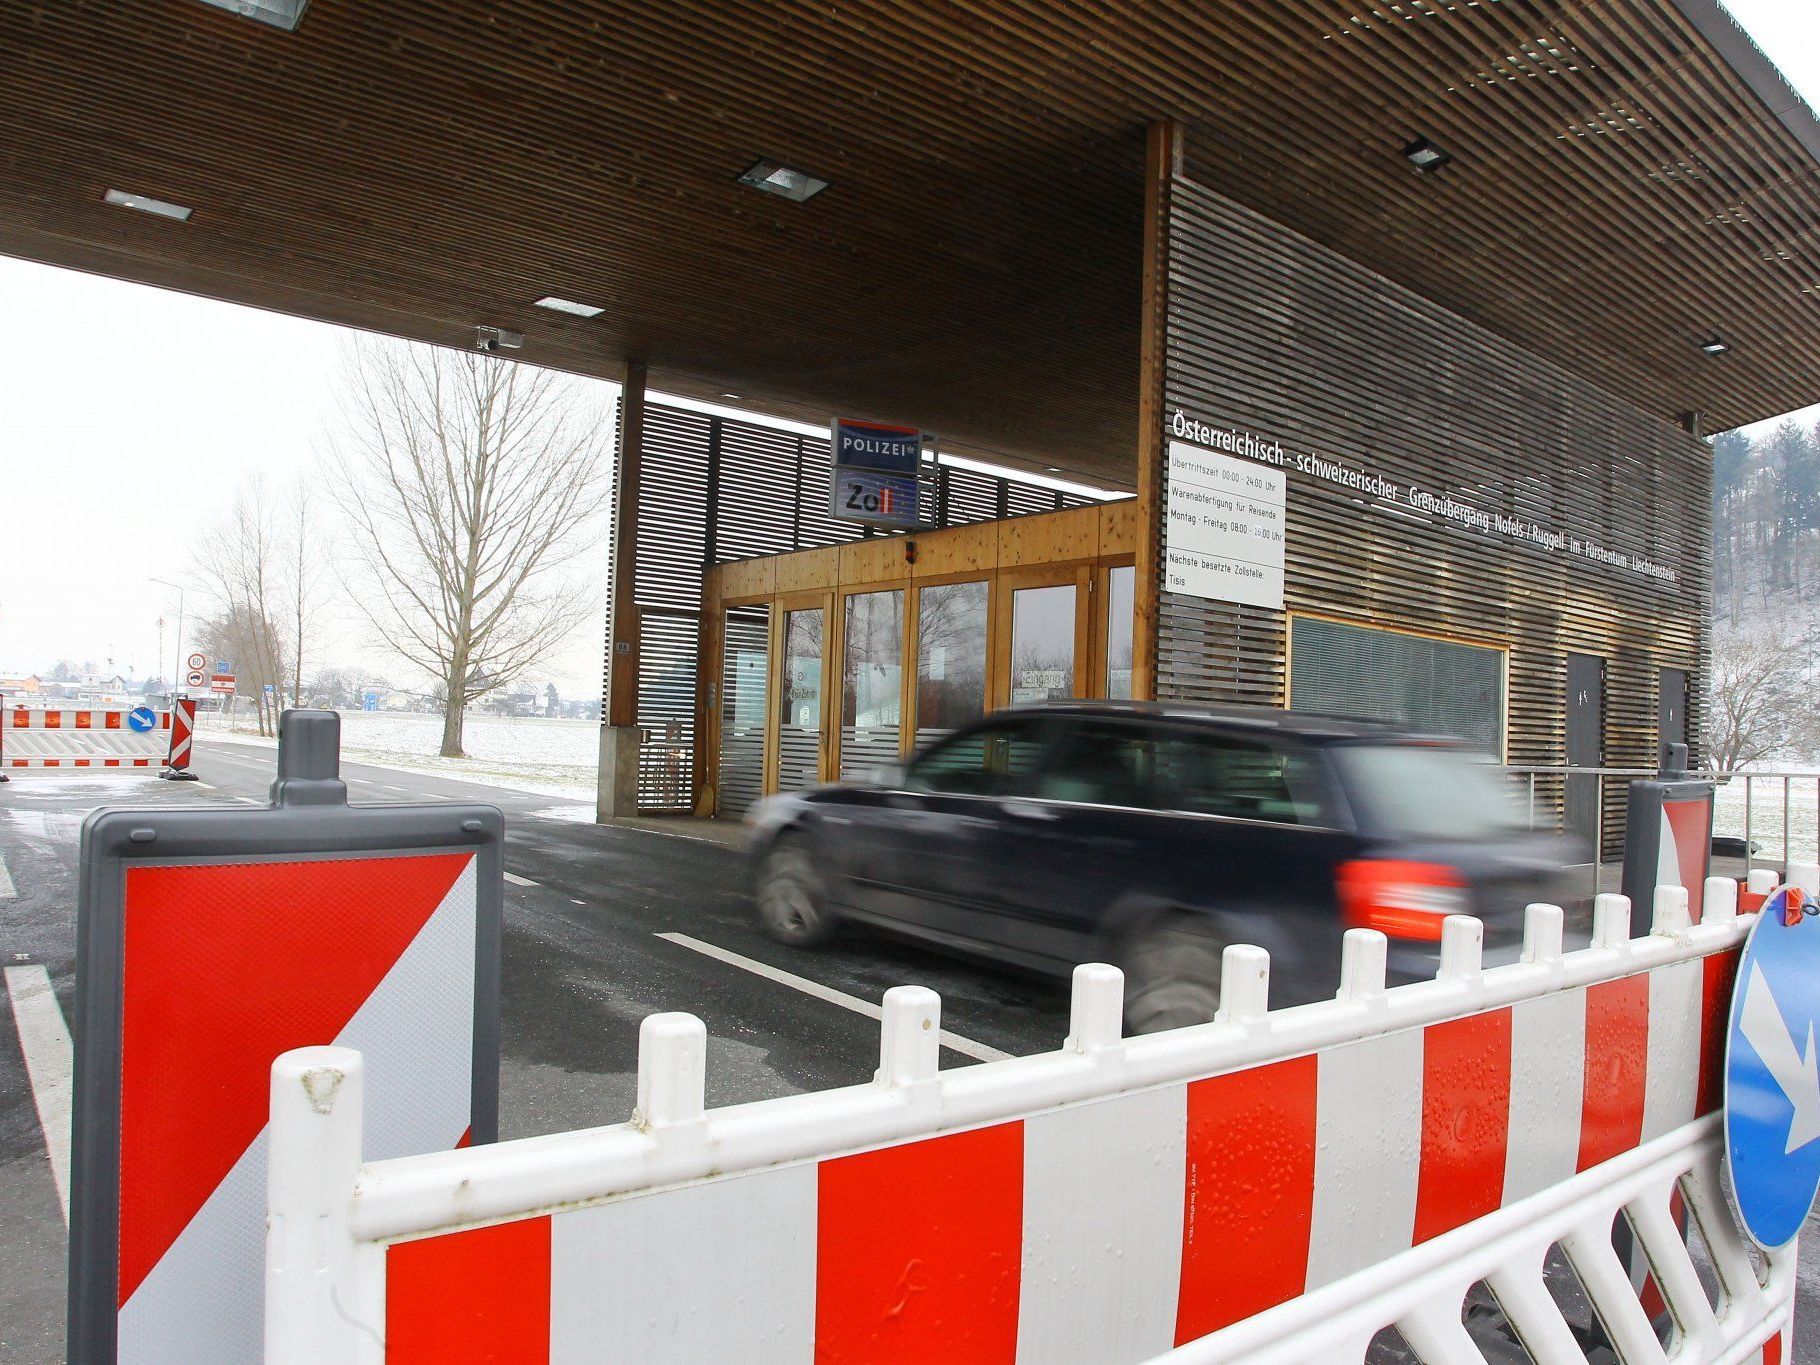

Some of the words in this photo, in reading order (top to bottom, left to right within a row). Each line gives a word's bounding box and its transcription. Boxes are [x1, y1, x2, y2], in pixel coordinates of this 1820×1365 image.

[843, 437, 905, 456] POLIZEI
[1171, 456, 1219, 477] Übertrittszeit
[1265, 480, 1276, 492] Uhr
[1171, 486, 1233, 512] Warenabfertigung
[1236, 502, 1246, 513] für
[1248, 504, 1277, 520] Reisende
[1173, 409, 1283, 466] Österreichisch
[1296, 452, 1398, 500] schweizerischer
[1409, 486, 1489, 533] Grenzübergang
[1494, 513, 1524, 538] Nofels
[1532, 524, 1565, 551] Ruggell
[1570, 536, 1581, 555] im
[1585, 540, 1627, 568] Fürstentum
[1632, 555, 1675, 581] Liechtenstein
[1170, 508, 1197, 526] Montag
[1203, 515, 1228, 532] Freitag
[1271, 530, 1282, 542] Uhr
[1169, 552, 1198, 568] Nächste
[1201, 558, 1231, 574] besetzte
[1234, 564, 1263, 579] Zollstelle
[1169, 574, 1186, 587] Tisis
